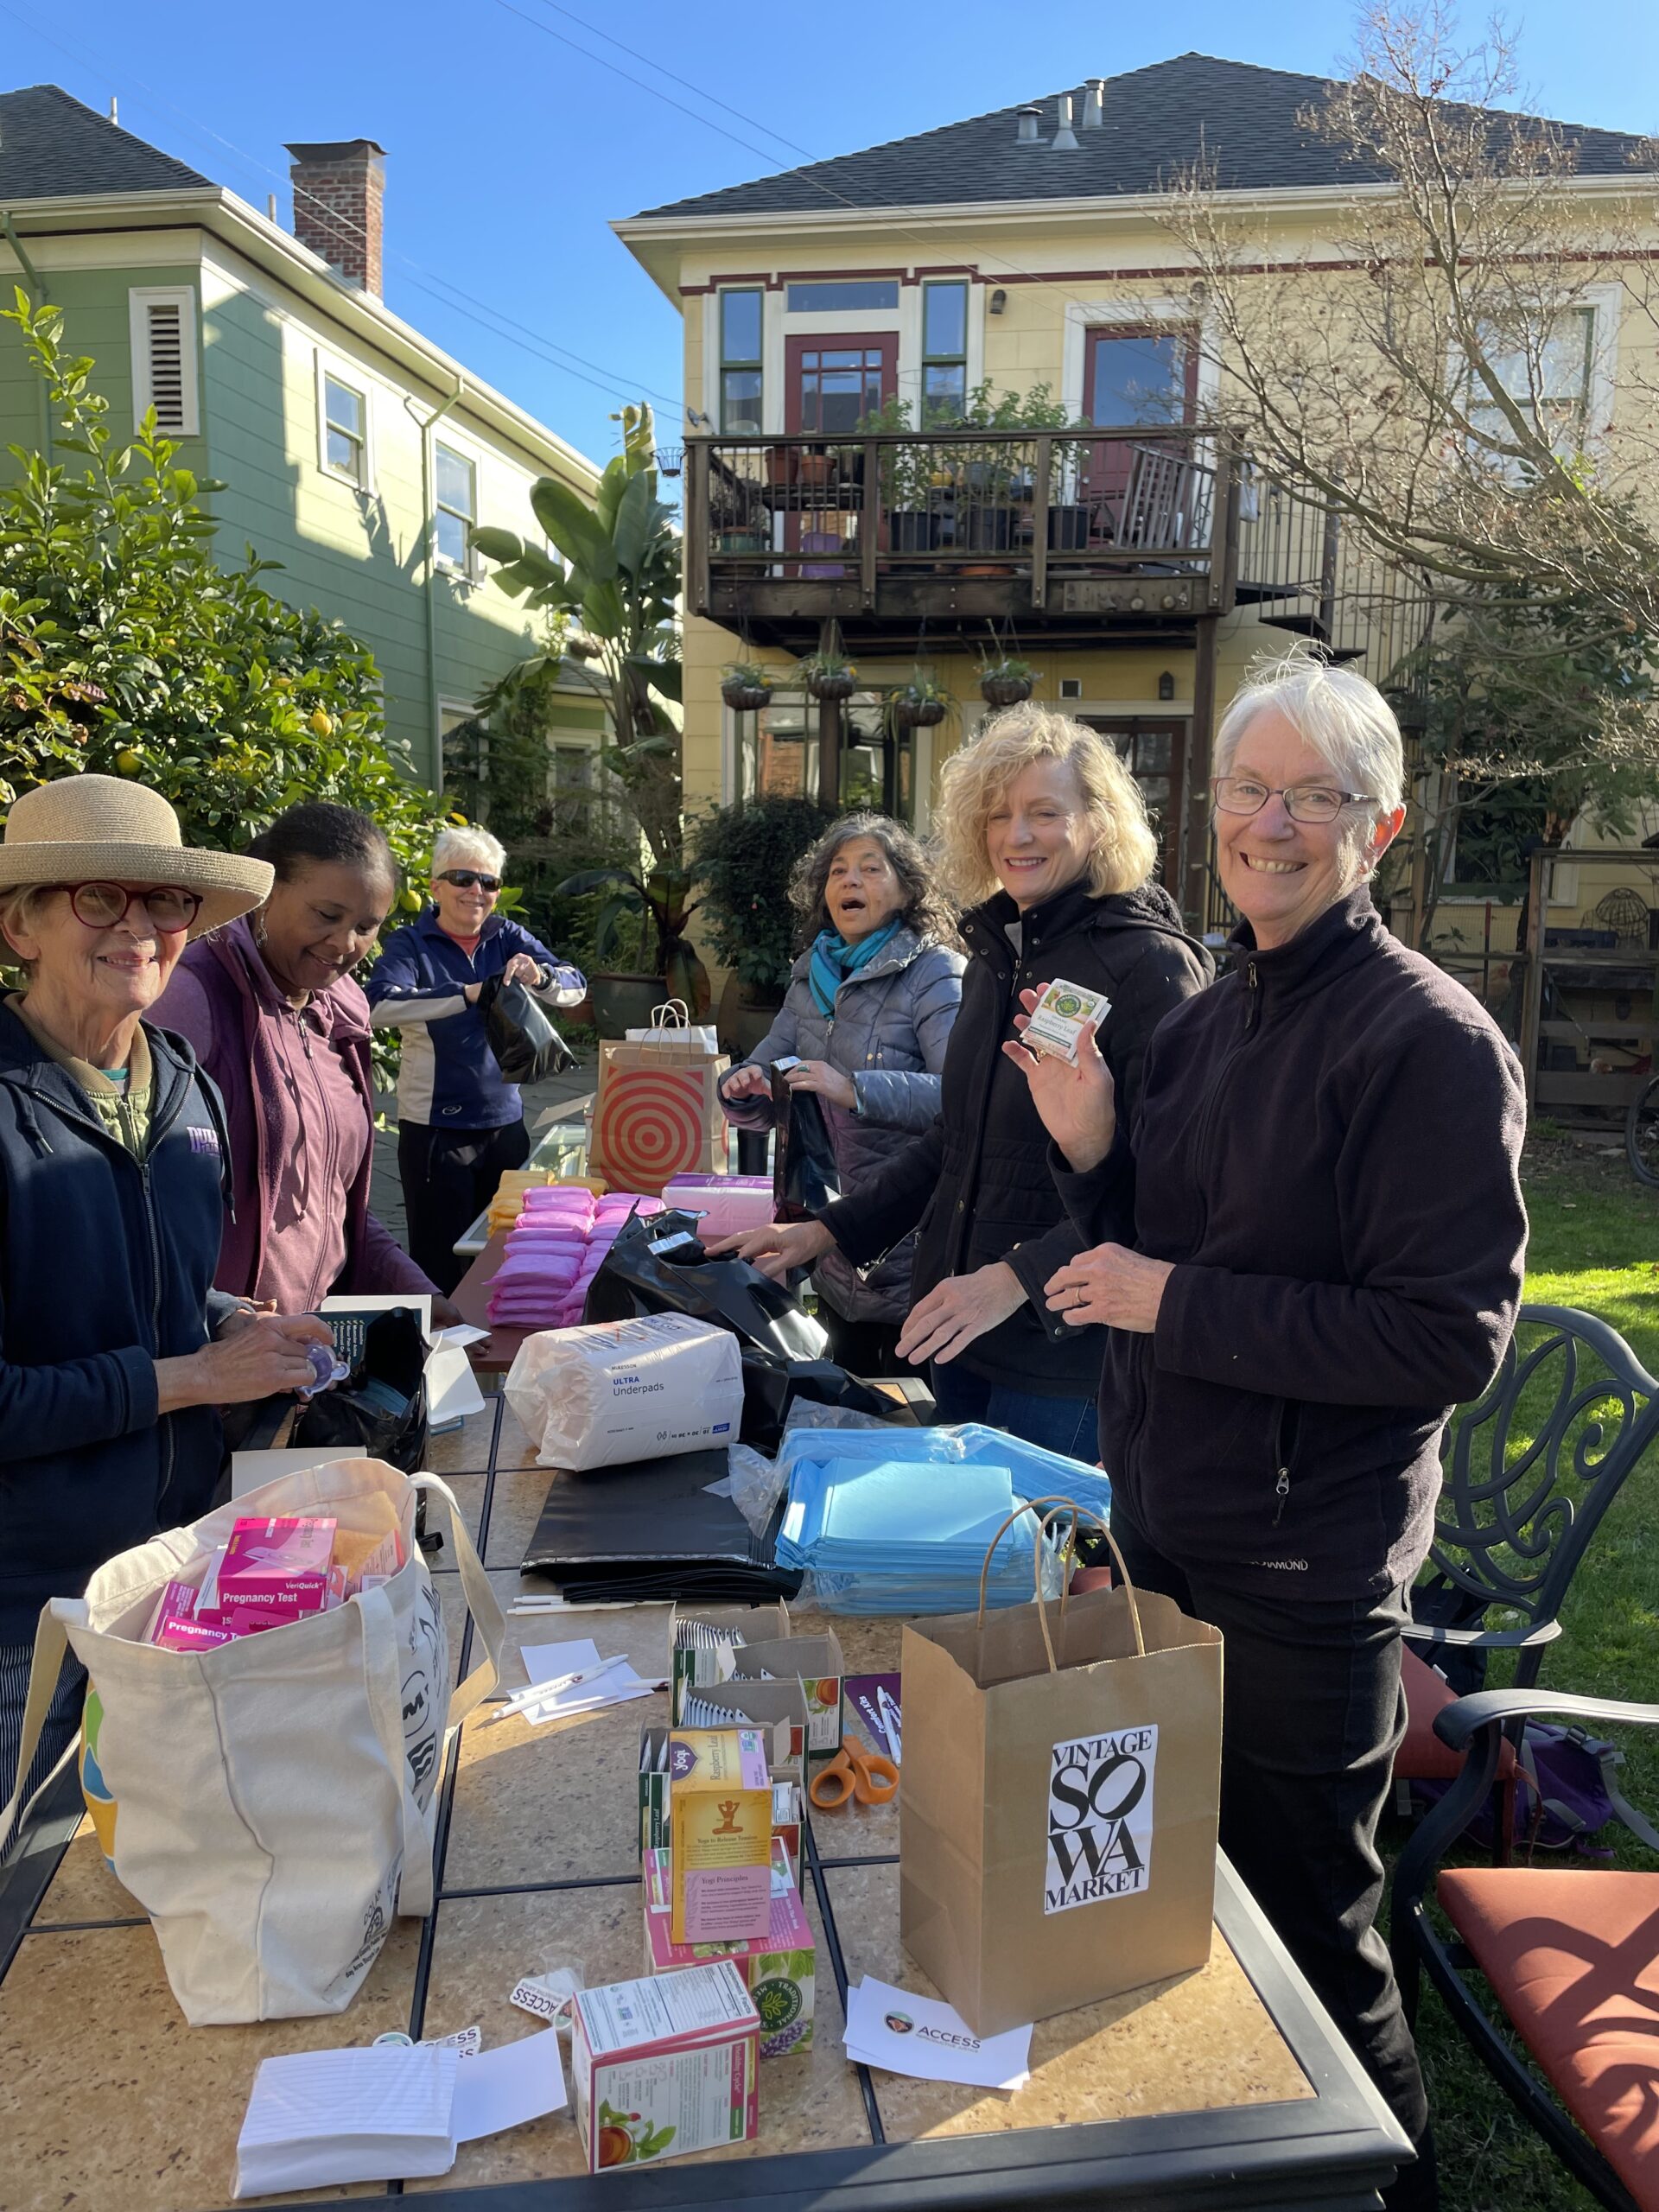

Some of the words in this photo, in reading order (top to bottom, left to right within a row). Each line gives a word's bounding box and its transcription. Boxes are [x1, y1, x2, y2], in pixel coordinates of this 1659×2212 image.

[613, 1376, 640, 1386] ULTRA
[613, 1382, 664, 1396] Underpads
[223, 1592, 275, 1605] Pregnancy
[276, 1592, 298, 1603] Test
[168, 1621, 228, 1641] Pregnancy
[858, 1695, 871, 1709] Kits
[1052, 1730, 1152, 1768] VINTAGE
[709, 1748, 721, 1781] Raspberry
[1050, 1754, 1147, 1834] SO
[1047, 1817, 1145, 1887] WA
[716, 1874, 748, 1883] Principles
[1046, 1867, 1145, 1911] MARKET
[512, 1988, 558, 2013] ACCESS
[775, 1980, 799, 2026] TRADITIONAL
[918, 2025, 982, 2050] ACCESS
